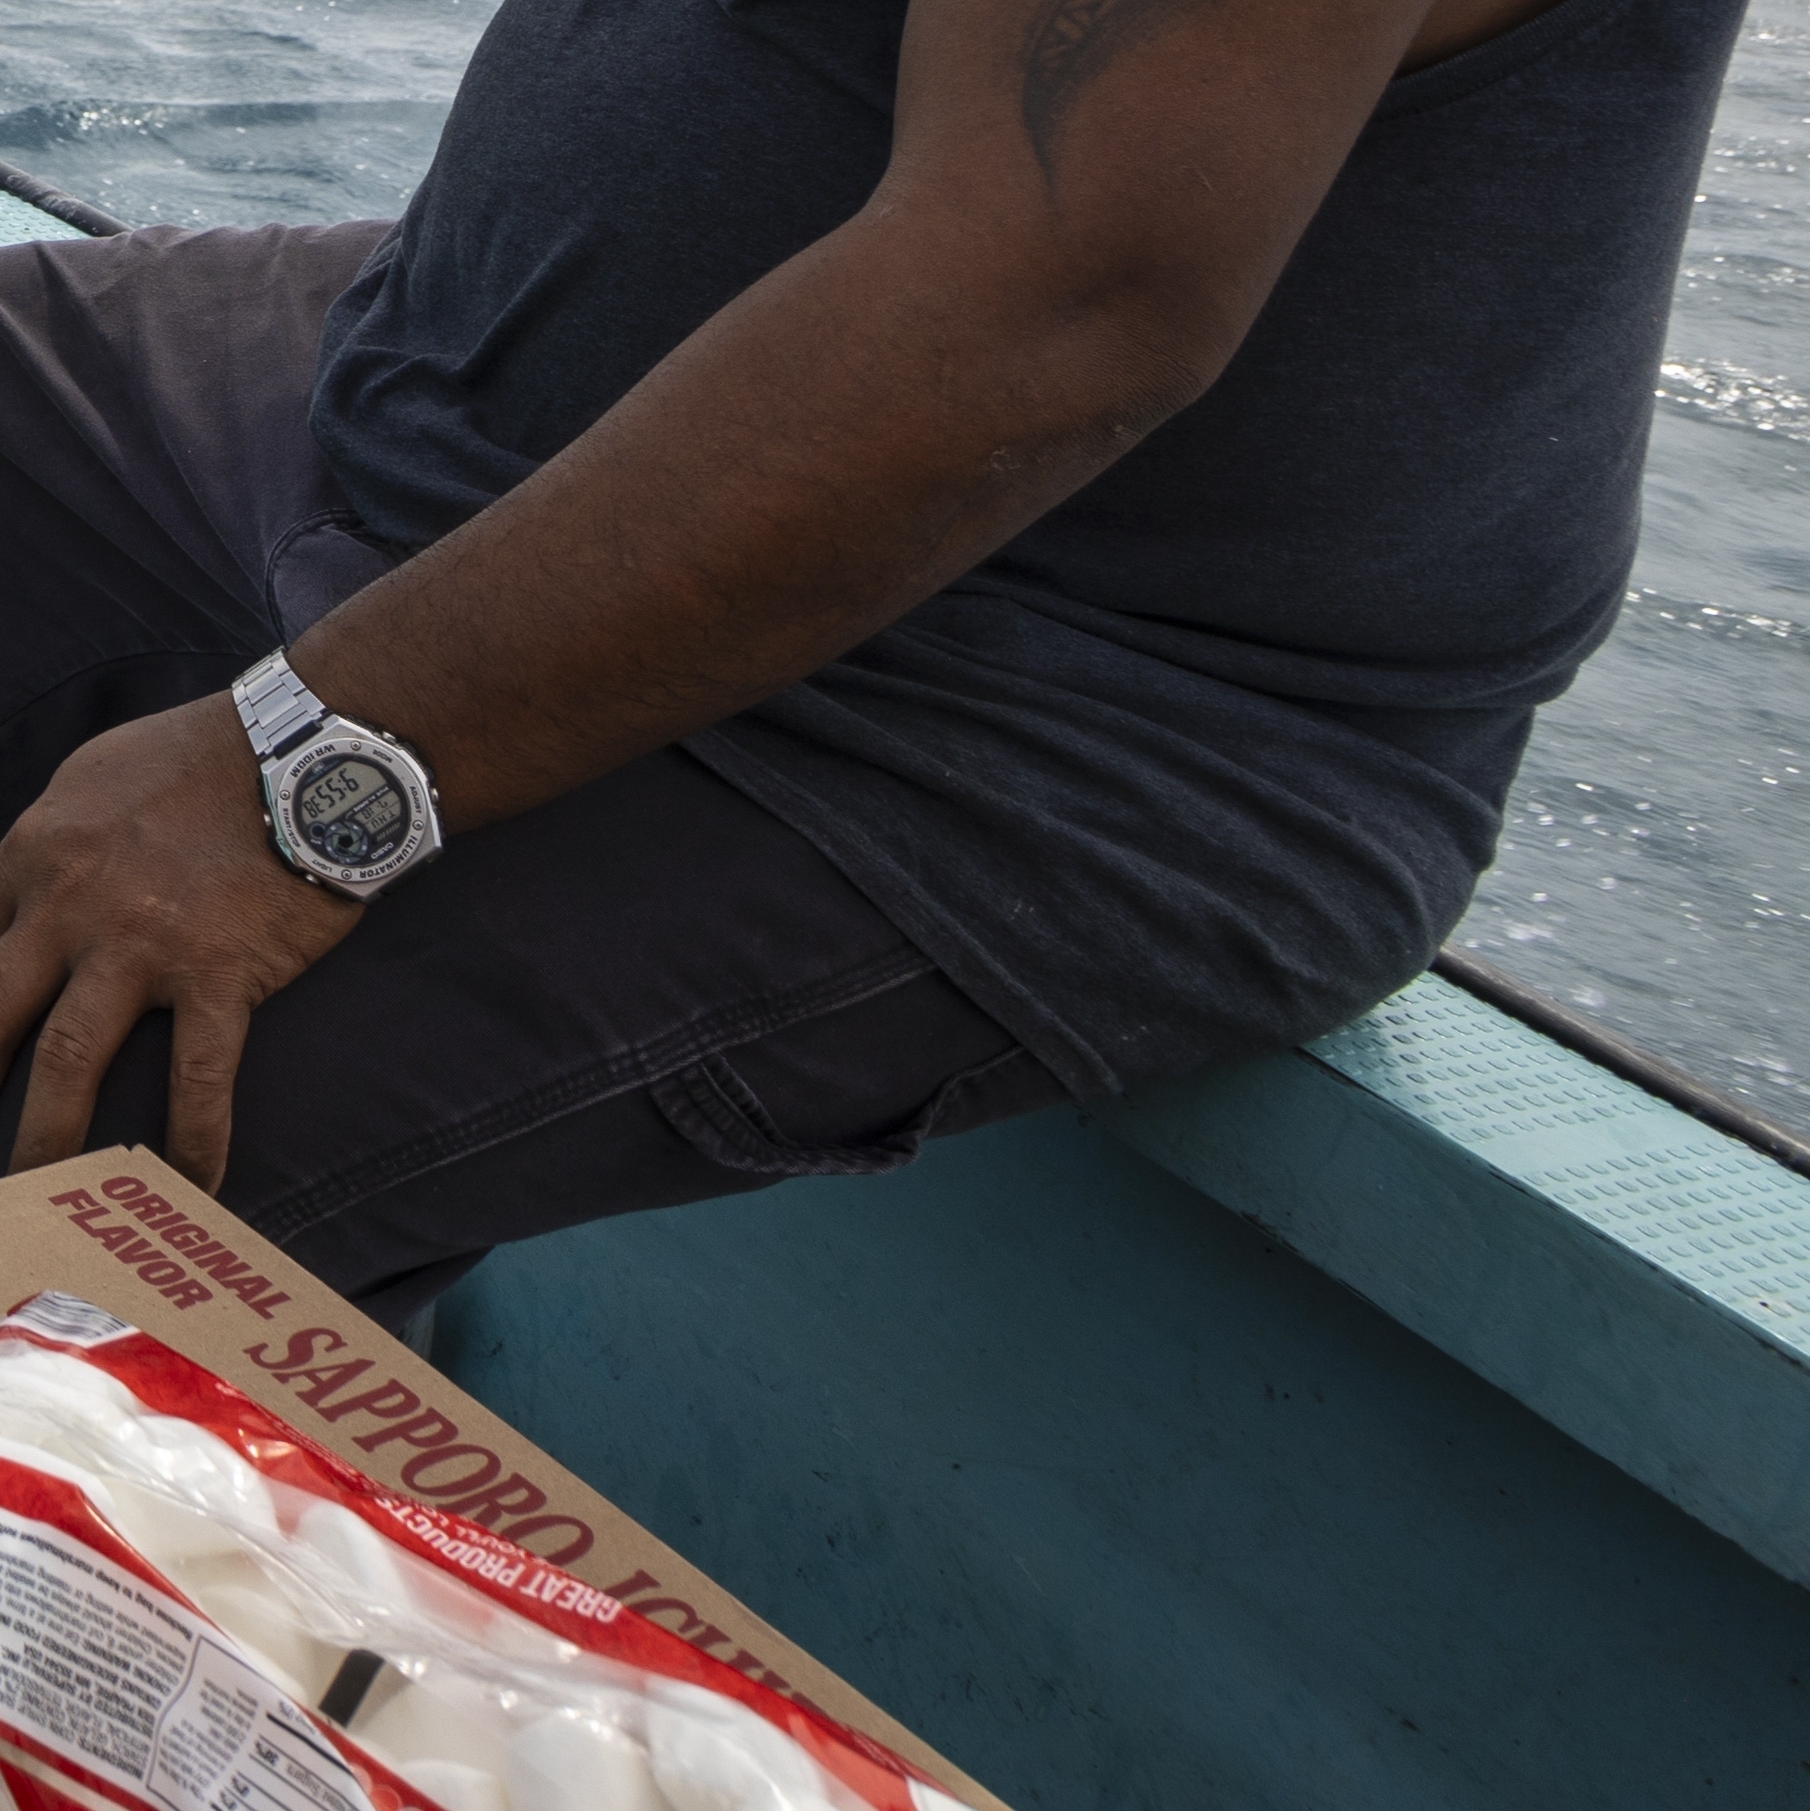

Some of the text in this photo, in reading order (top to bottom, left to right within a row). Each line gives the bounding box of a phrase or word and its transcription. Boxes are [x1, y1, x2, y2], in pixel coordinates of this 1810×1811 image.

[358, 834, 417, 878] ILLUMINATOR
[48, 1188, 214, 1311] FLAVOR
[100, 1175, 292, 1321] ORIGINAL
[243, 1326, 595, 1570] SAPPORO
[18, 1529, 94, 1577] marshmallows
[373, 1493, 622, 1624] GREAT PRODUCTS
[94, 1569, 120, 1593] keep
[120, 1585, 132, 1600] to
[134, 1593, 153, 1614] bag
[12, 1618, 41, 1643] FOOD
[22, 1643, 43, 1663] USA
